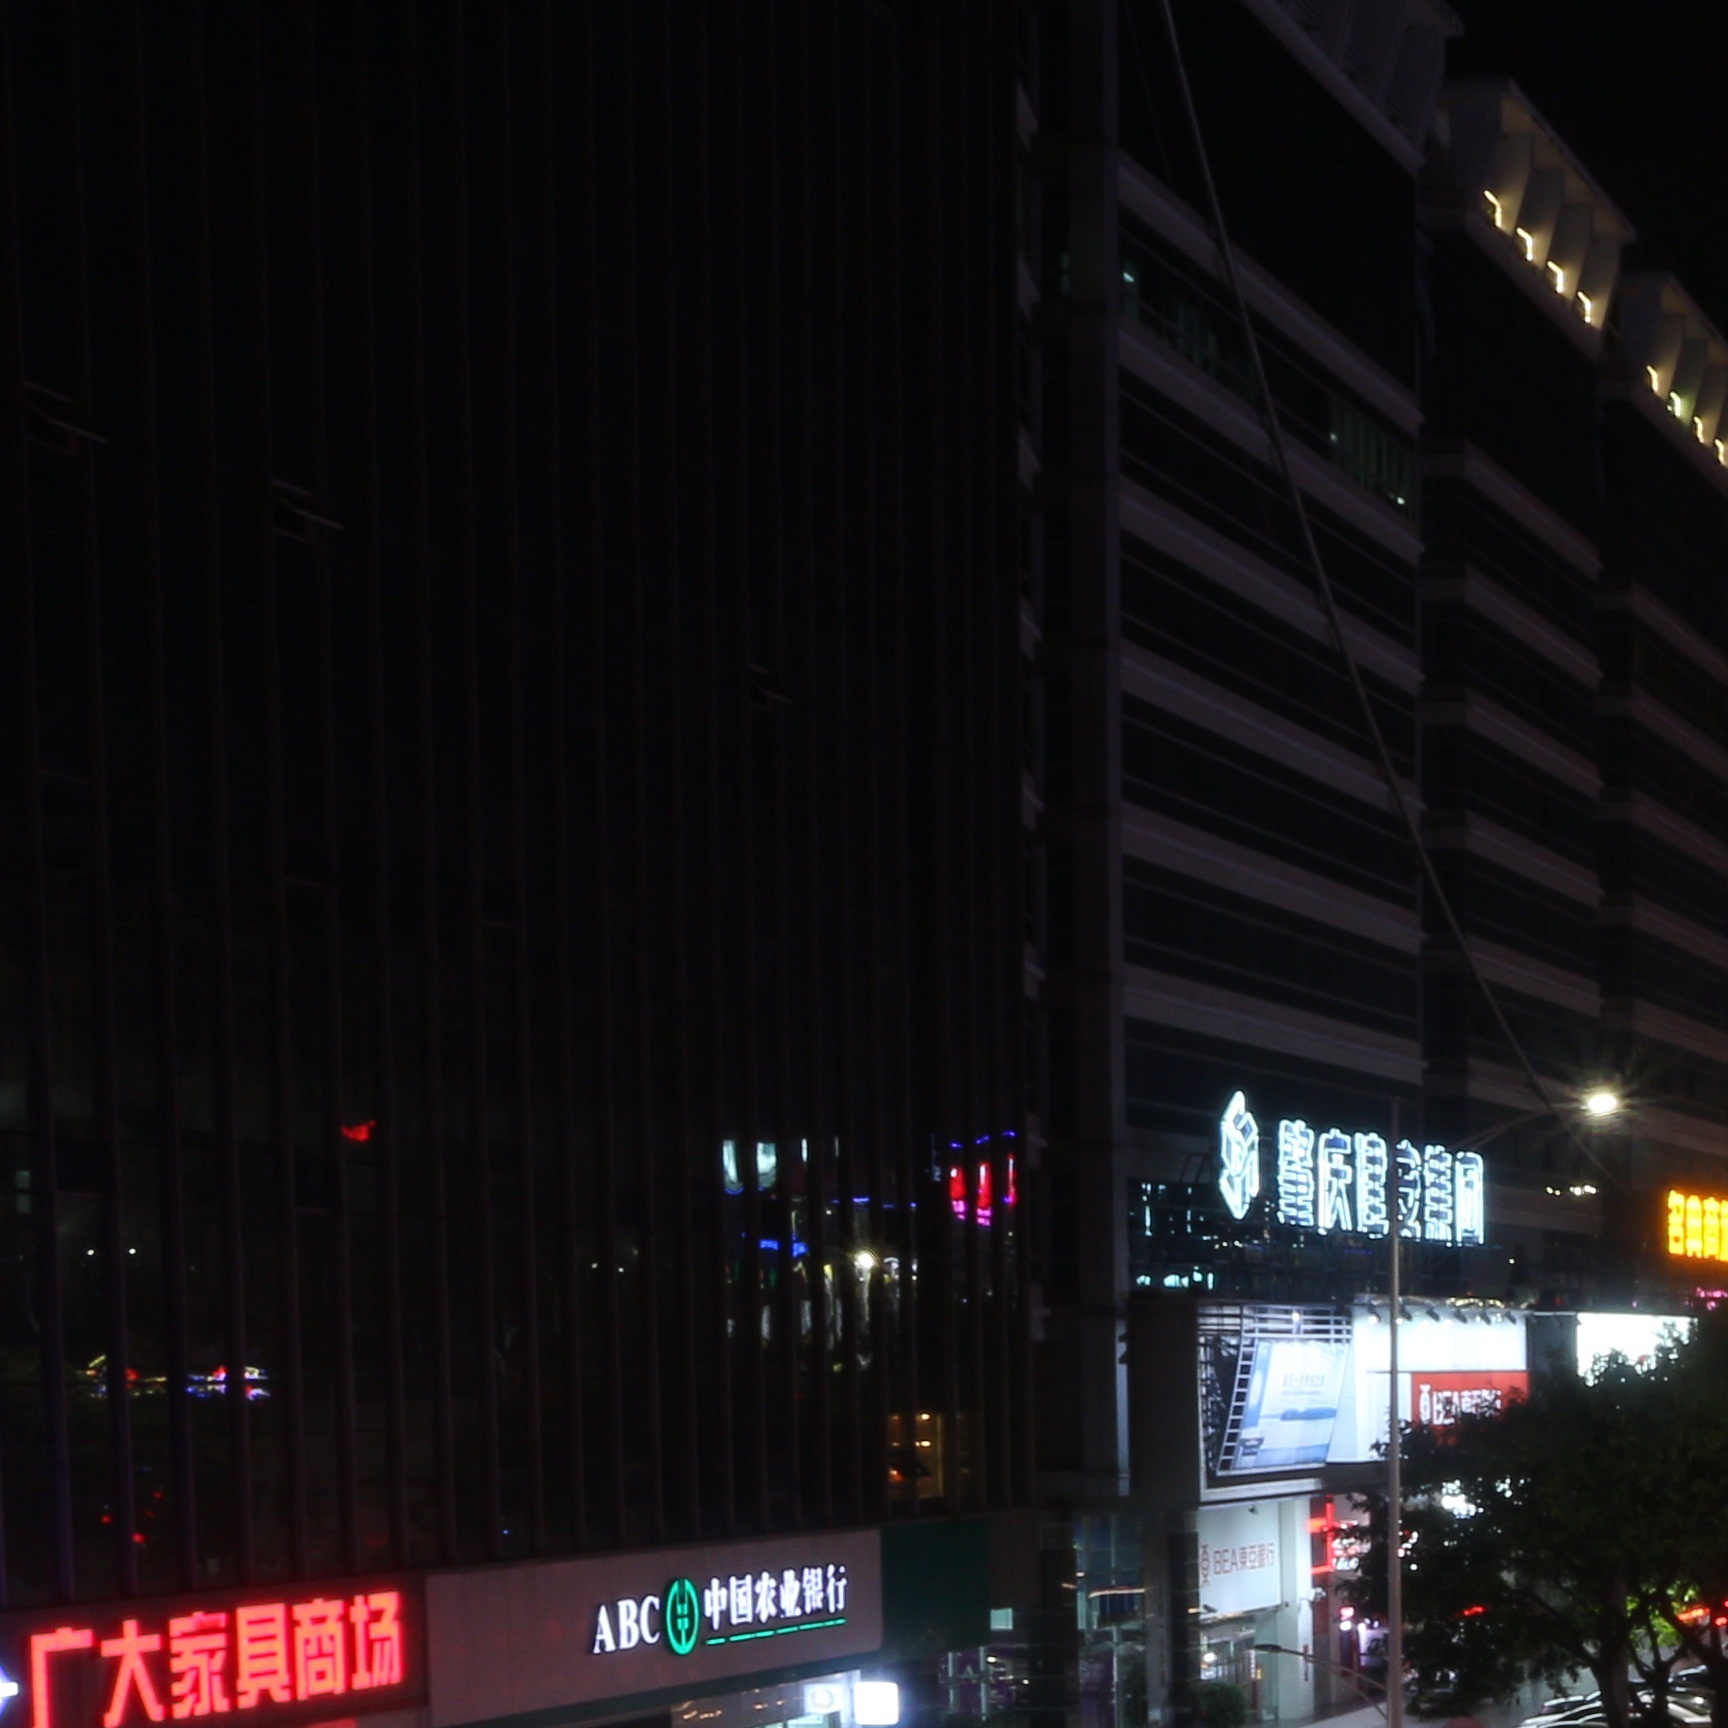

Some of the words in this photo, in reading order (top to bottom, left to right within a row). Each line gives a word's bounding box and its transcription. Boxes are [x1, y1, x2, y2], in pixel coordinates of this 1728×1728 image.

[593, 1595, 661, 1654] ABC
[703, 1564, 848, 1631] 中国农业银行
